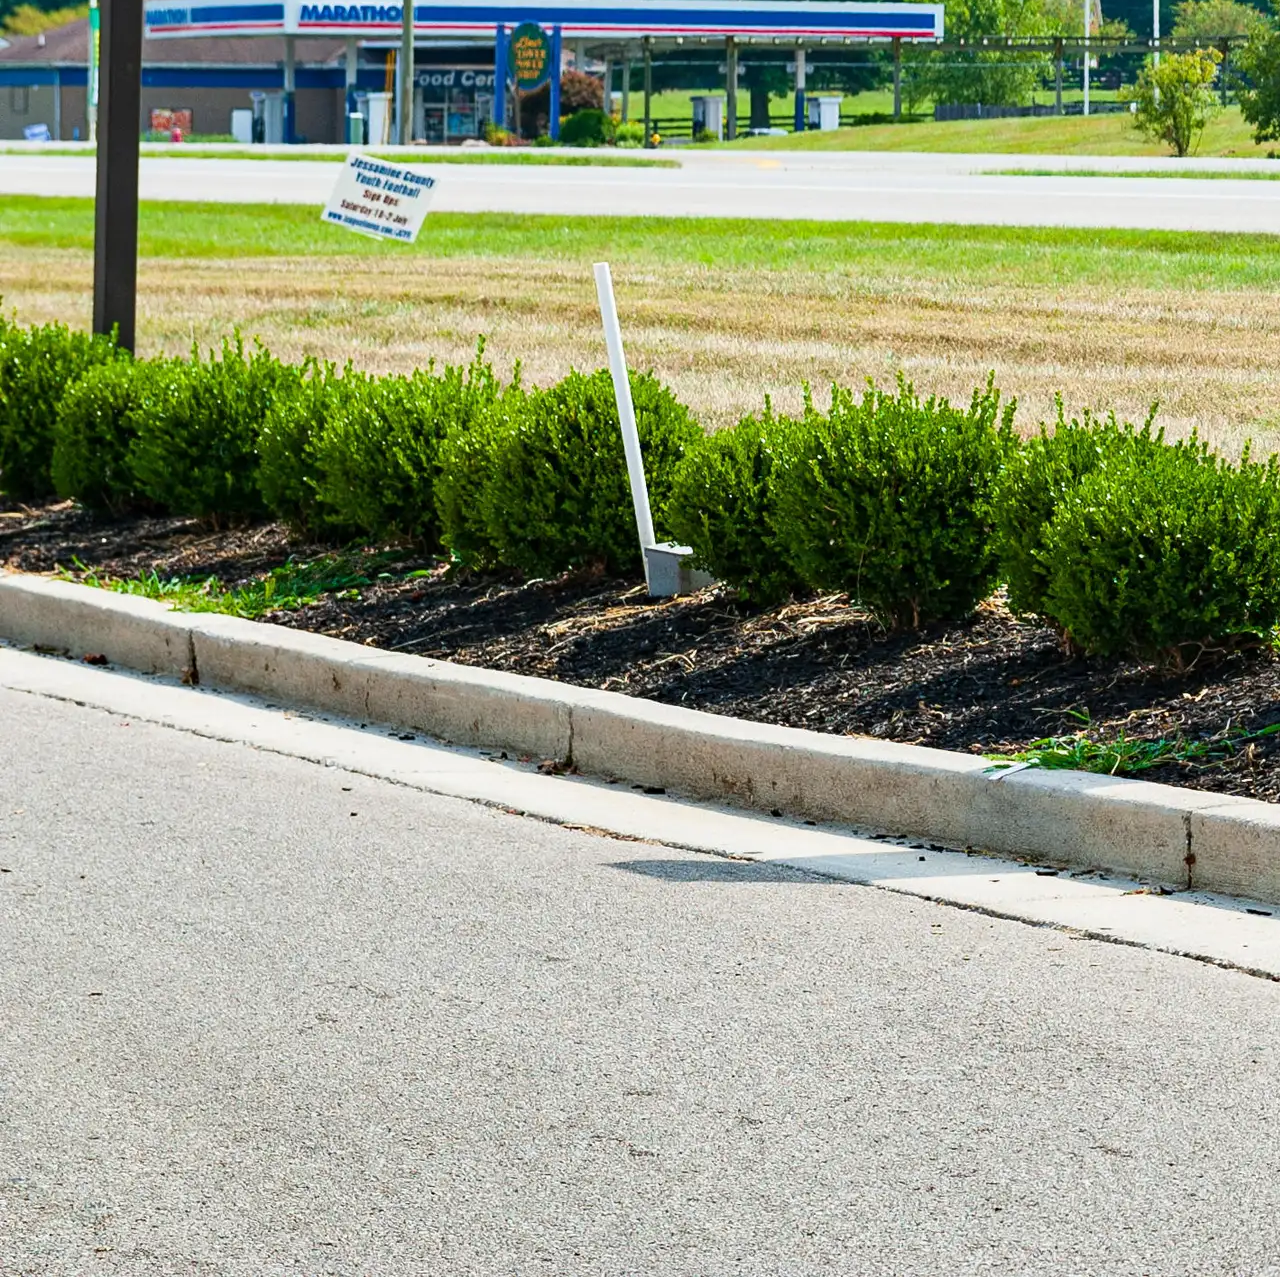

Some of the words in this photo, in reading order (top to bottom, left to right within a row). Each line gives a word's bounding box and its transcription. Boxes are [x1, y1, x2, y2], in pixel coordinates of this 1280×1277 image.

[350, 157, 402, 179] Jessamine
[403, 170, 435, 189] County
[355, 171, 382, 188] Youth
[383, 179, 421, 199] Football
[362, 189, 381, 202] Sign
